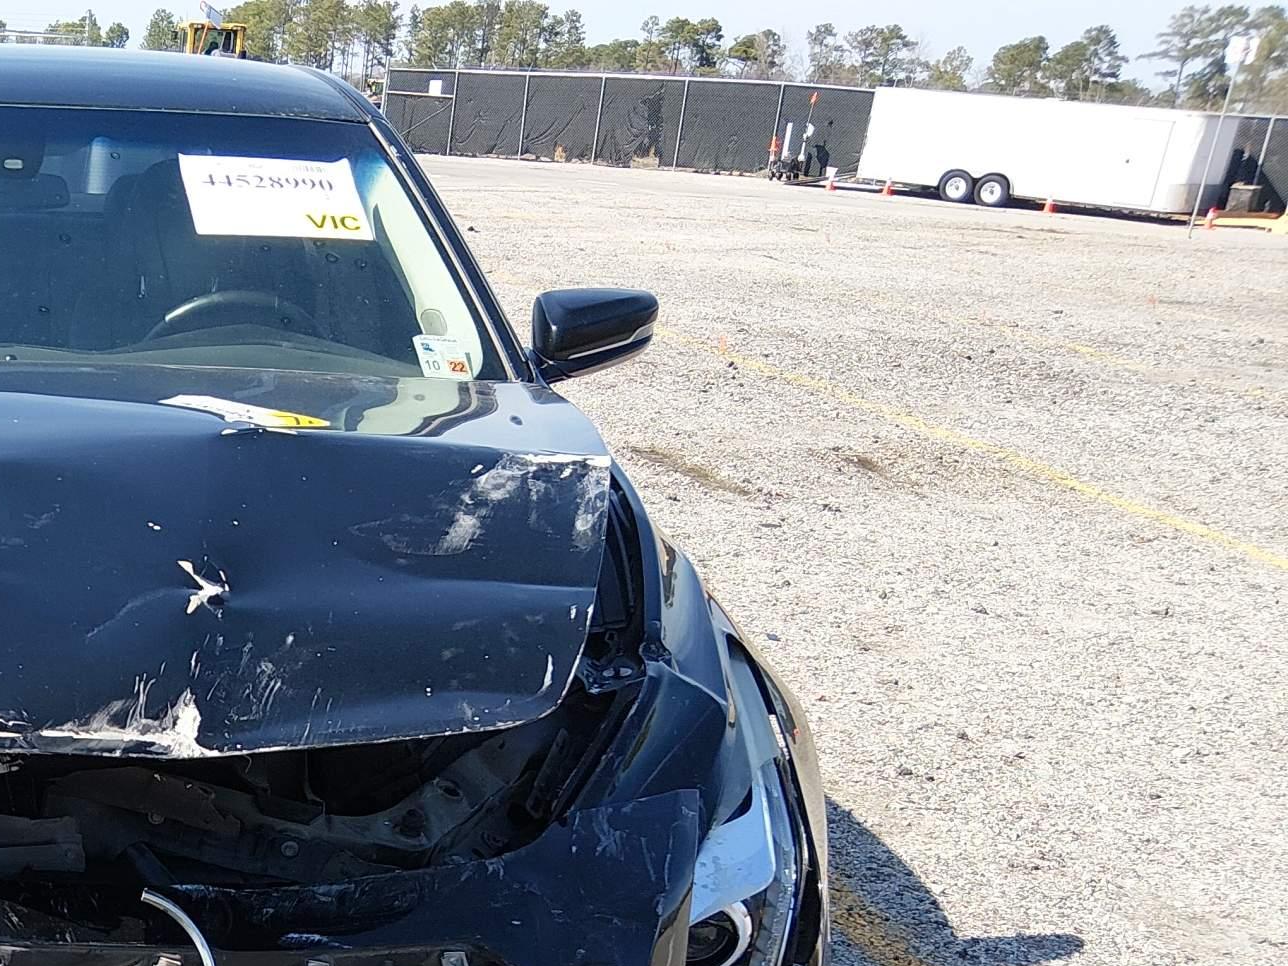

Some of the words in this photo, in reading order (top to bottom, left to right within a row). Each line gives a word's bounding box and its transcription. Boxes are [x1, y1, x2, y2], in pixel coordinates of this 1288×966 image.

[306, 213, 362, 231] VIC
[425, 360, 440, 370] 10
[449, 362, 468, 372] 22
